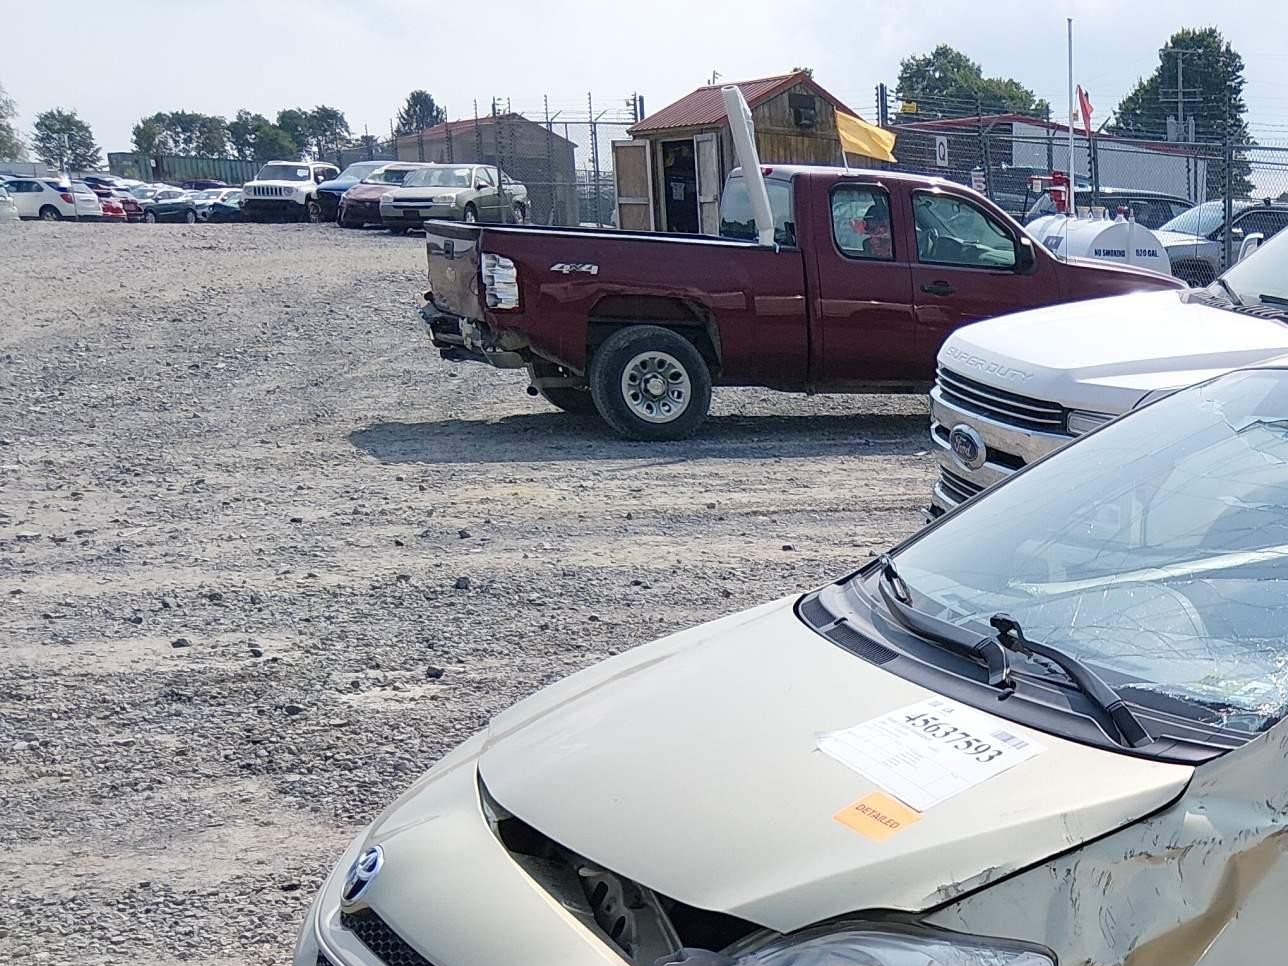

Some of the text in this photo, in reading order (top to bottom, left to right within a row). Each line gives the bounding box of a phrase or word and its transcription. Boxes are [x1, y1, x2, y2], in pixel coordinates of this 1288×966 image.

[938, 141, 946, 161] Q
[1094, 248, 1102, 257] NO
[946, 346, 1035, 384] SUPER DUTY
[954, 435, 972, 457] Ford
[904, 711, 1004, 763] 45637593
[855, 803, 900, 830] DETAILED
